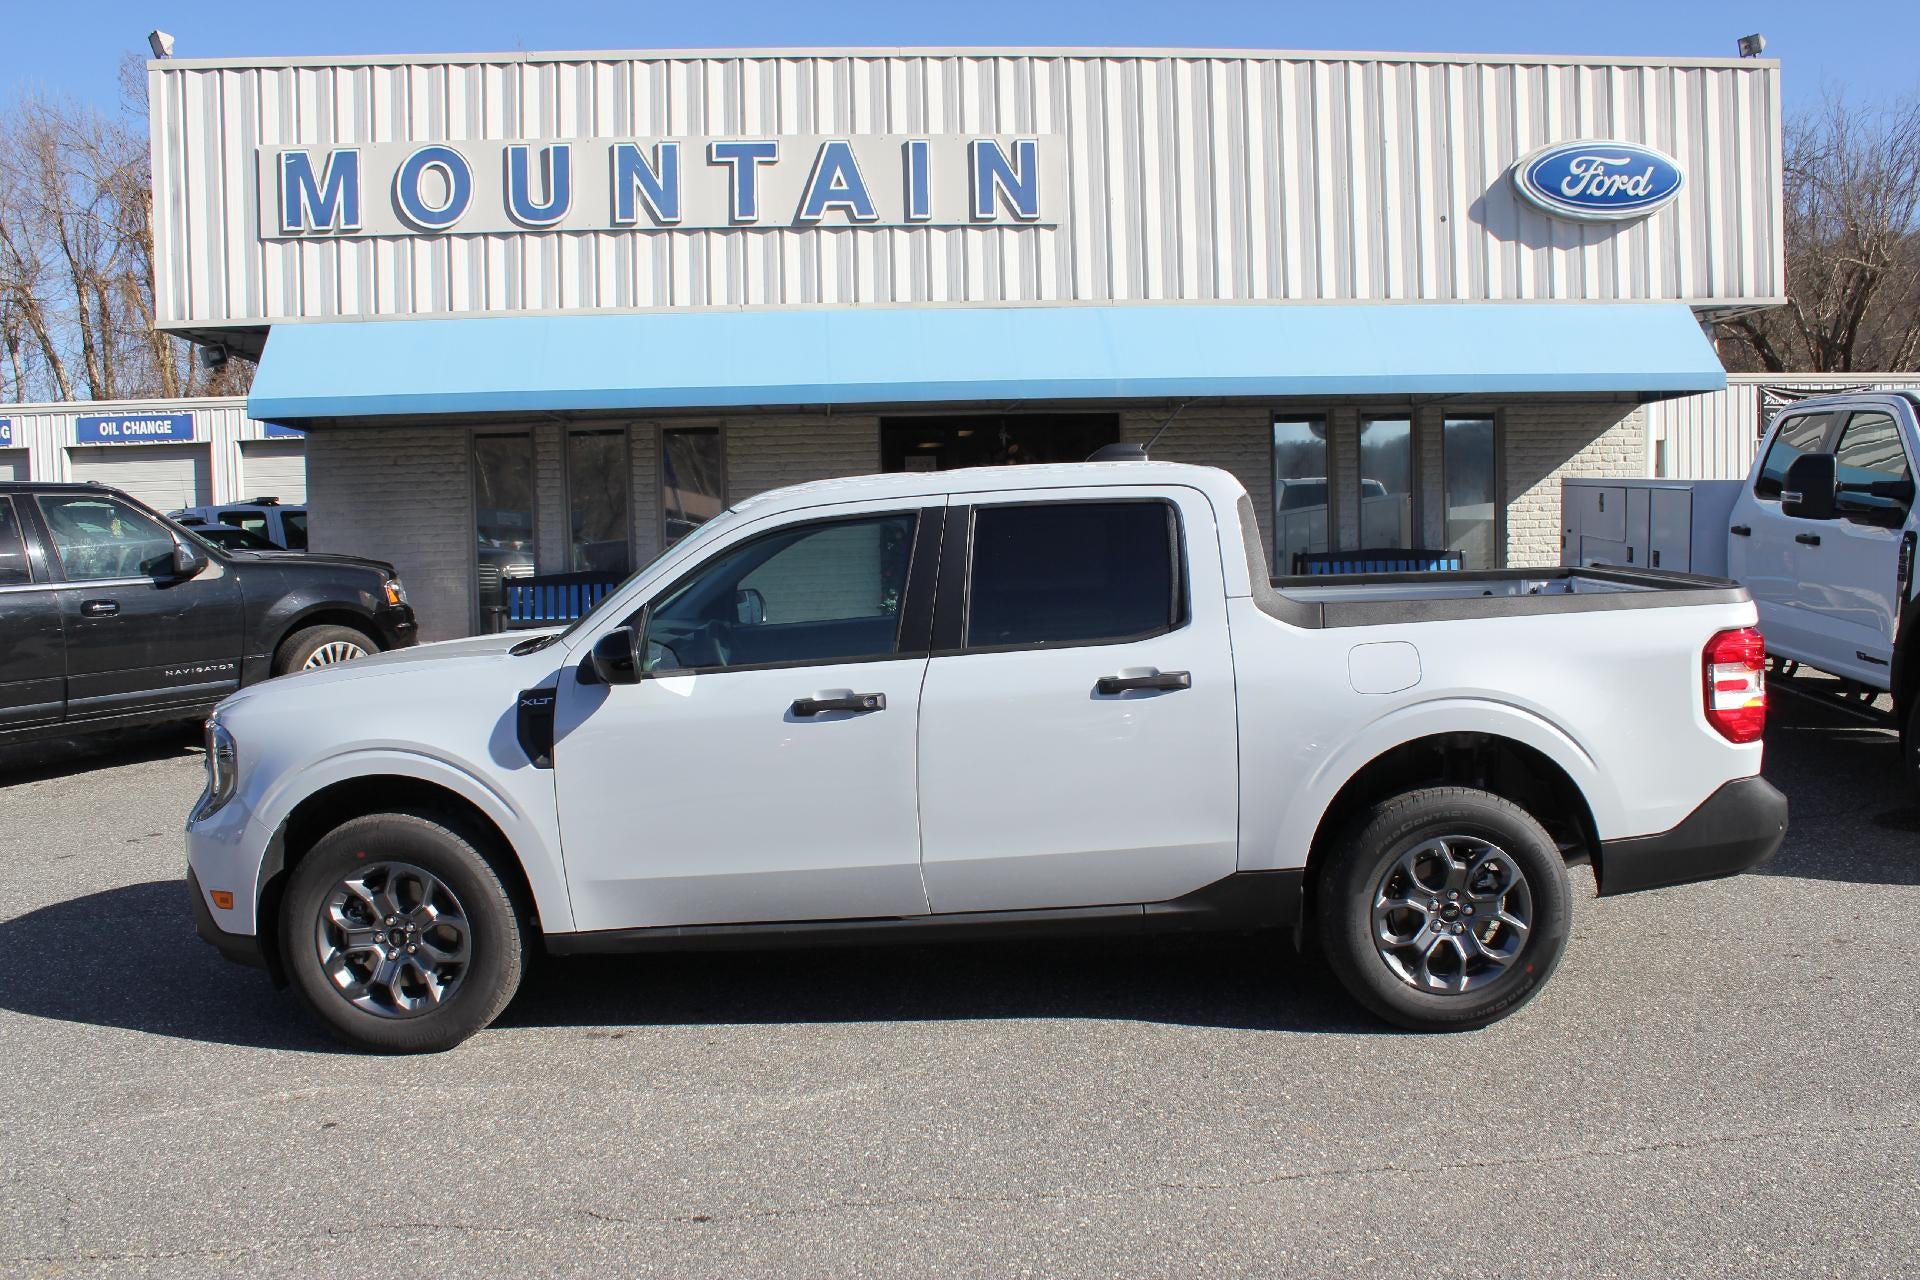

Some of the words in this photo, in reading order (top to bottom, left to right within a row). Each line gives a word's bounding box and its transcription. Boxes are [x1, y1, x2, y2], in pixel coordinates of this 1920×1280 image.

[1561, 156, 1653, 197] Ford
[279, 138, 1041, 233] MOUNTAIN
[99, 422, 119, 436] OIL
[123, 420, 172, 435] CHANGE
[165, 663, 235, 676] NAVIGATOR
[521, 697, 553, 707] XLT
